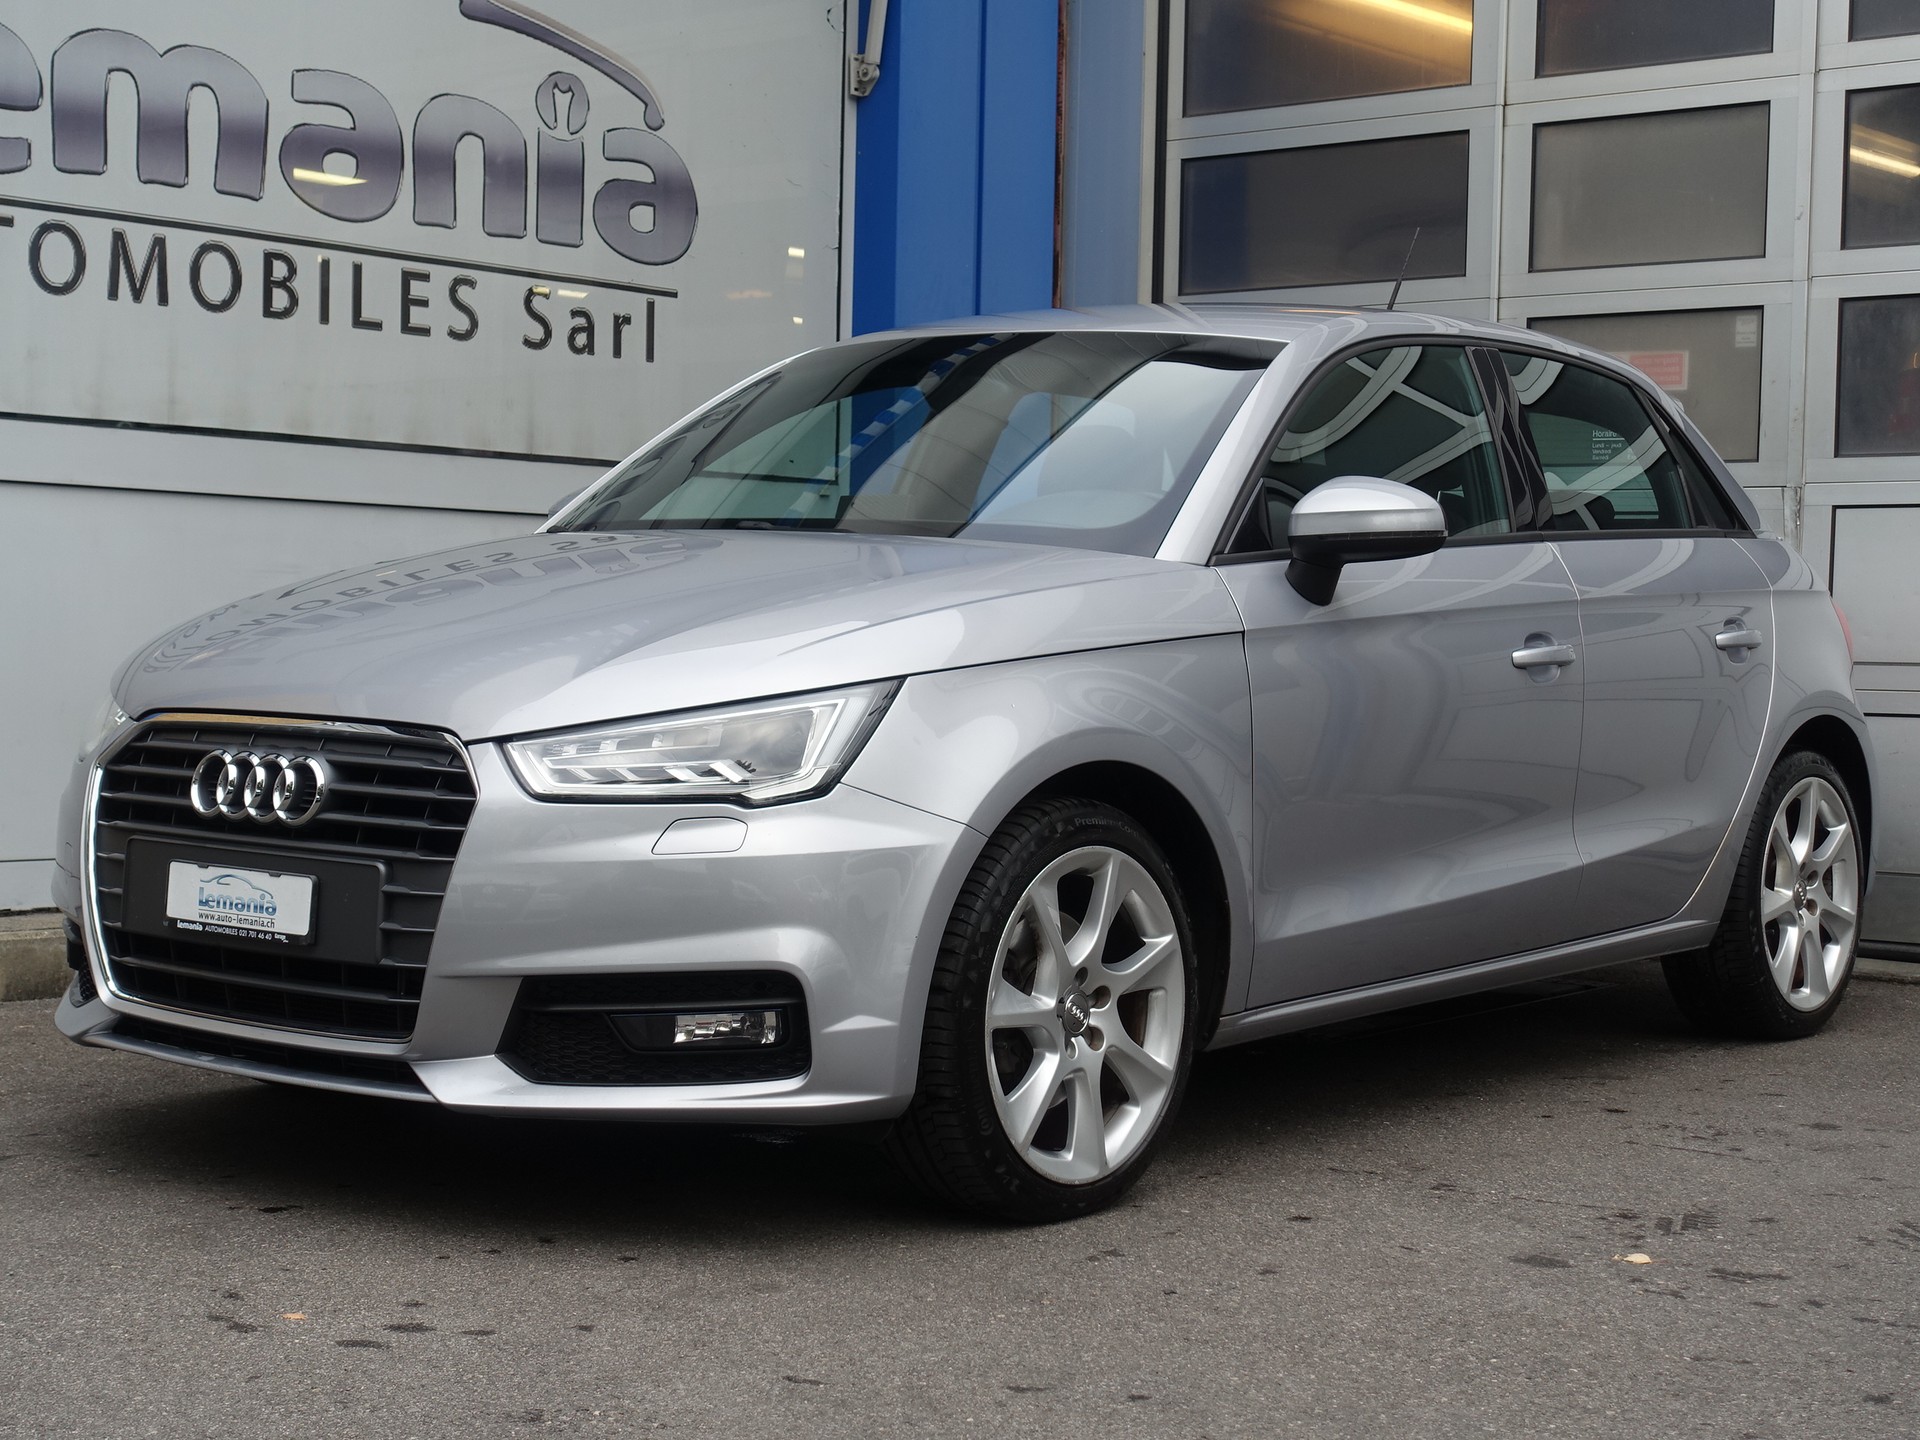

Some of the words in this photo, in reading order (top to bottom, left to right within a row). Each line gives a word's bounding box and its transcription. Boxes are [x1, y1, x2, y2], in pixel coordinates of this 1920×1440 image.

[0, 214, 480, 342] OMOBILES
[522, 284, 656, 363] Sarl
[198, 887, 277, 916] Lemania
[198, 912, 275, 929] www.auto-lemania.ch
[205, 925, 238, 936] AUTOMOBILES
[239, 929, 248, 937] 021
[248, 930, 257, 938] 701
[258, 932, 265, 940] 46
[265, 933, 273, 941] 40
